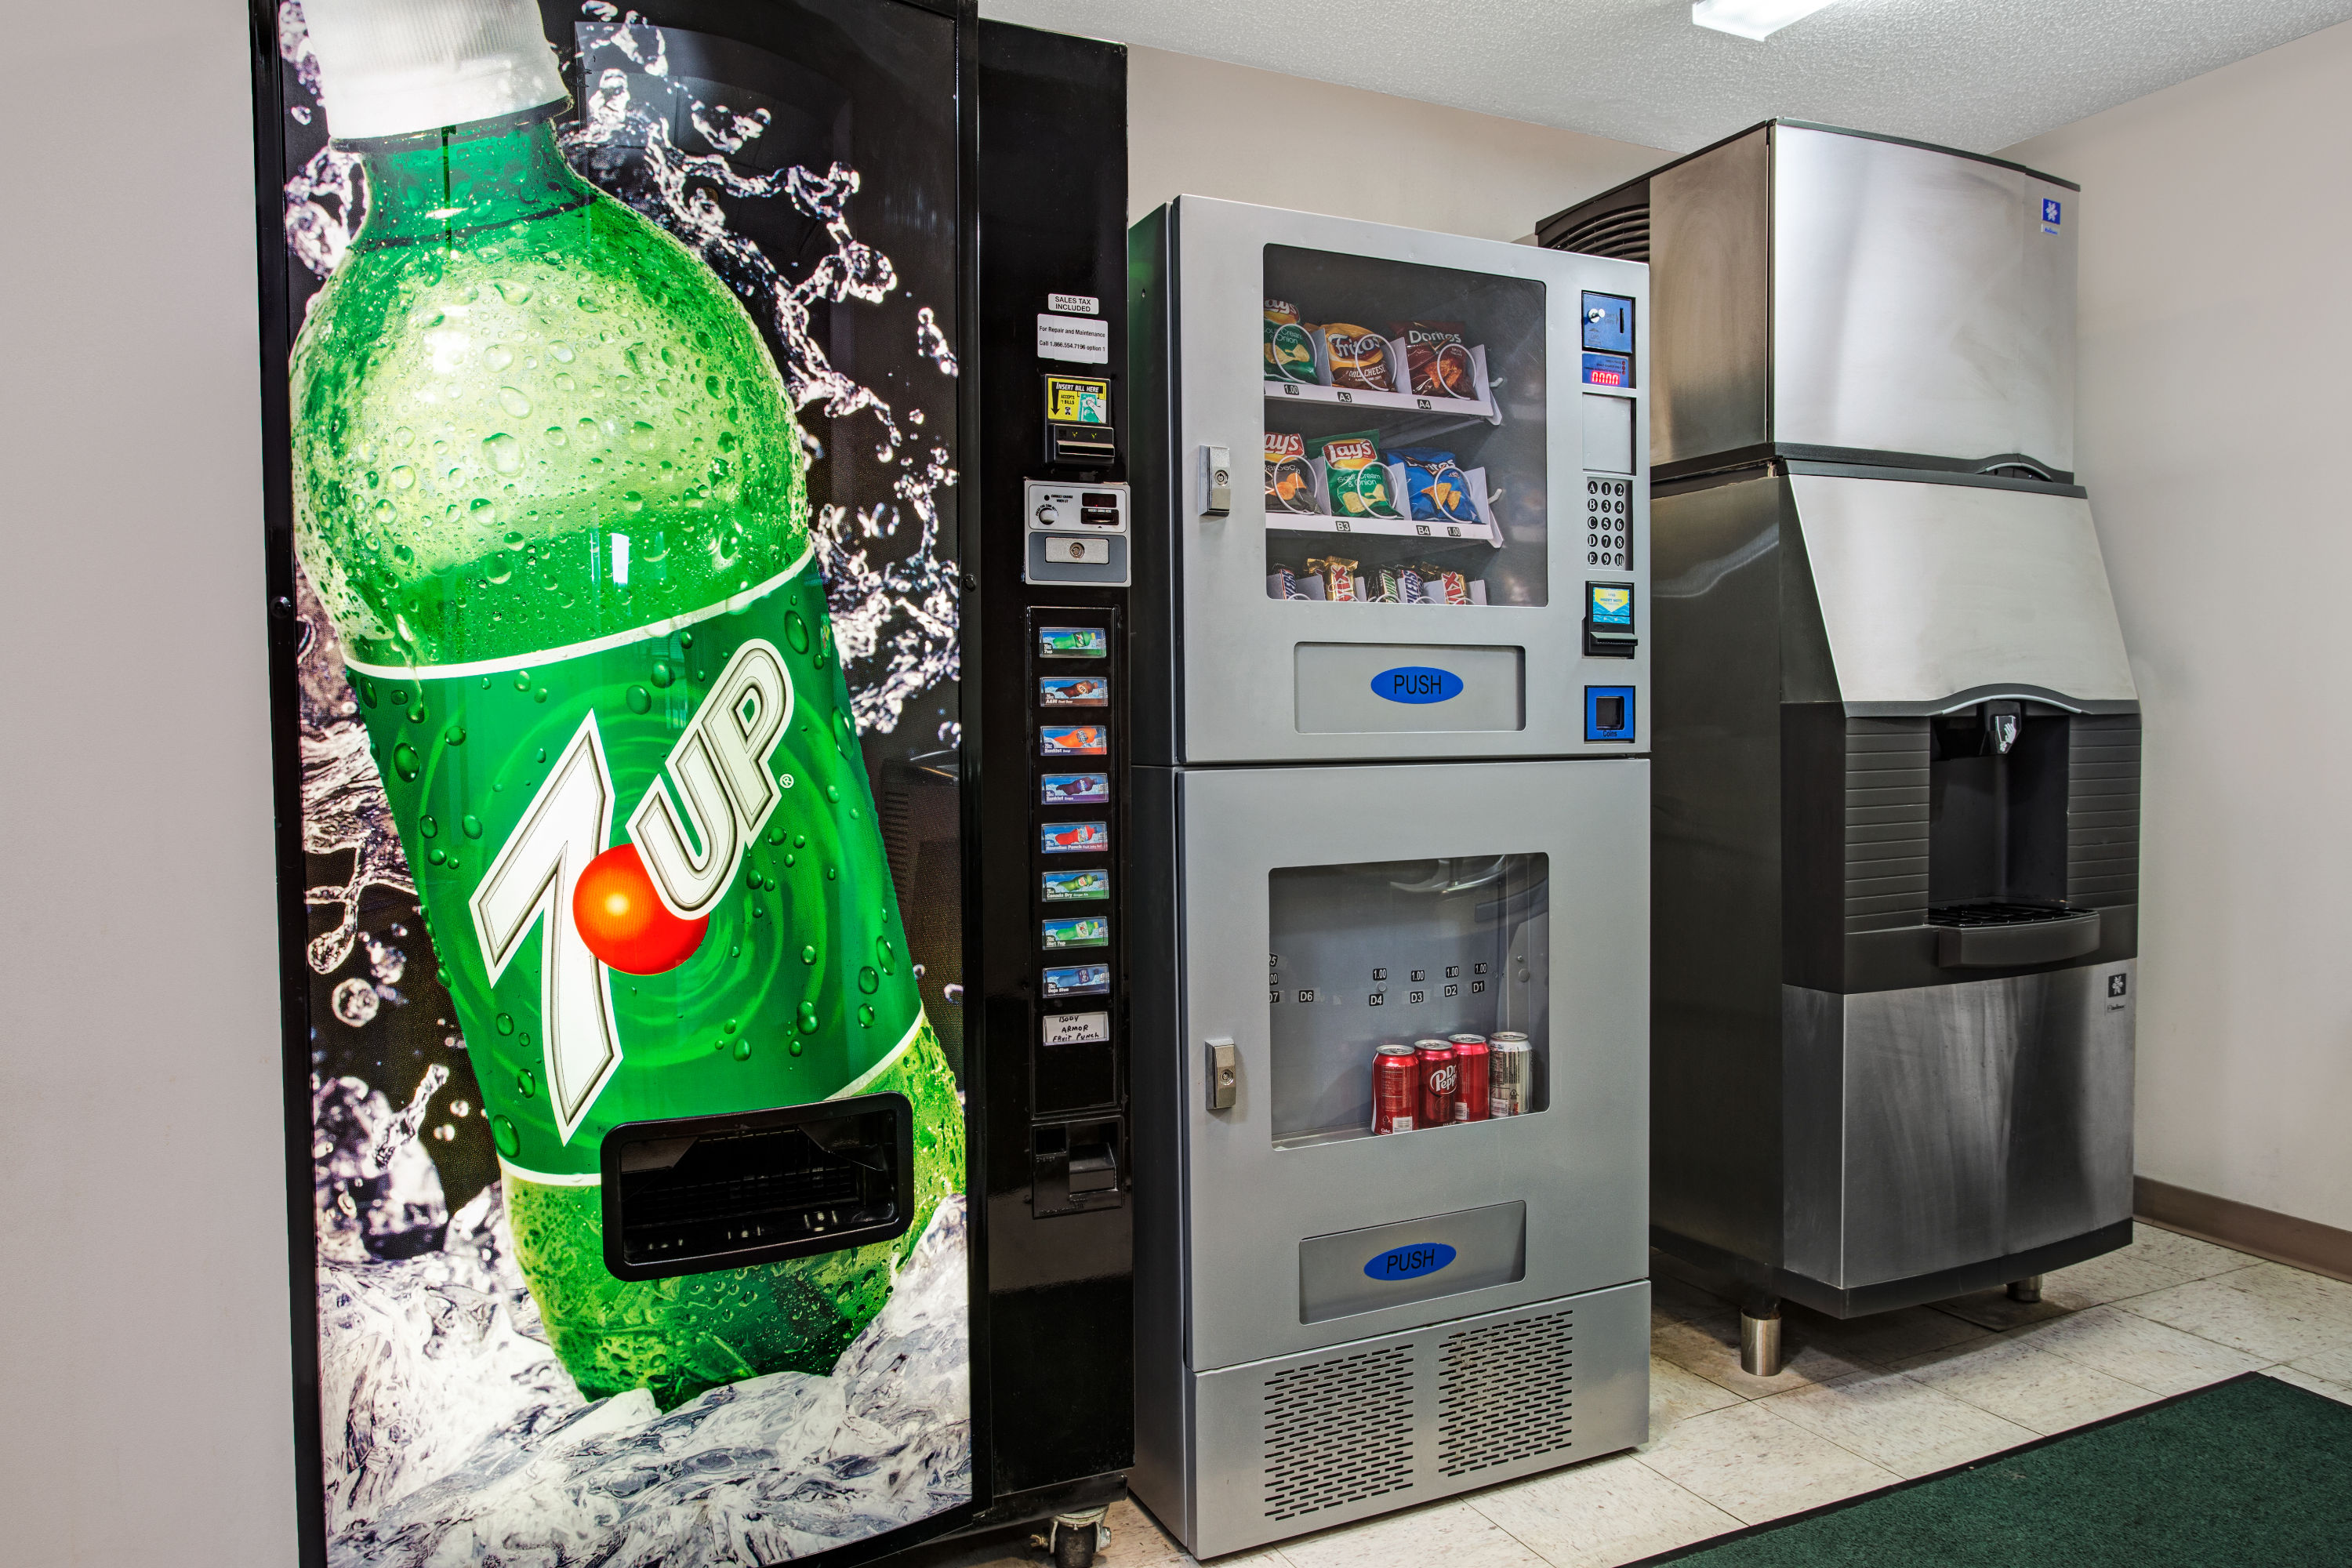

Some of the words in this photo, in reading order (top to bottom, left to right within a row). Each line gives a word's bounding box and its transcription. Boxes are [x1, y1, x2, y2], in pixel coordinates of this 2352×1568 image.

[1055, 303, 1091, 312] INCLUDED
[1076, 329, 1105, 338] Maintenance
[1409, 330, 1461, 343] Doritos
[1328, 333, 1380, 358] Fritos
[1056, 382, 1073, 390] INSERT
[1284, 385, 1298, 394] 1.00
[1328, 443, 1372, 463] Lay's
[1338, 474, 1356, 483] Sour
[1588, 484, 1596, 493] A
[1617, 485, 1623, 495] 2
[1588, 500, 1596, 510] B
[1603, 500, 1609, 510] 3
[1617, 502, 1623, 512] 4
[1337, 522, 1349, 531] B3
[1588, 517, 1596, 528] C
[1603, 518, 1609, 528] 5
[1617, 520, 1622, 530] 6
[1417, 526, 1430, 535] B4
[1447, 527, 1461, 536] 1.00
[1588, 535, 1596, 546] D
[1603, 536, 1609, 546] 7
[1617, 538, 1622, 547] 8
[1588, 554, 1595, 564] E
[1603, 554, 1610, 564] 9
[1616, 555, 1624, 565] 10
[1394, 674, 1442, 695] PUSH
[1373, 969, 1387, 979] 1.00
[1411, 971, 1425, 981] 1.00
[1446, 967, 1458, 977] 1.00
[1475, 964, 1487, 974] 1.00
[1300, 991, 1312, 1001] D6
[1370, 995, 1383, 1005] D4
[1411, 993, 1422, 1003] D3
[1446, 985, 1457, 996] D2
[1473, 982, 1483, 993] D1
[1062, 1024, 1088, 1033] ARMOR
[1446, 1065, 1457, 1079] Dr
[1386, 1248, 1435, 1274] PUSH
